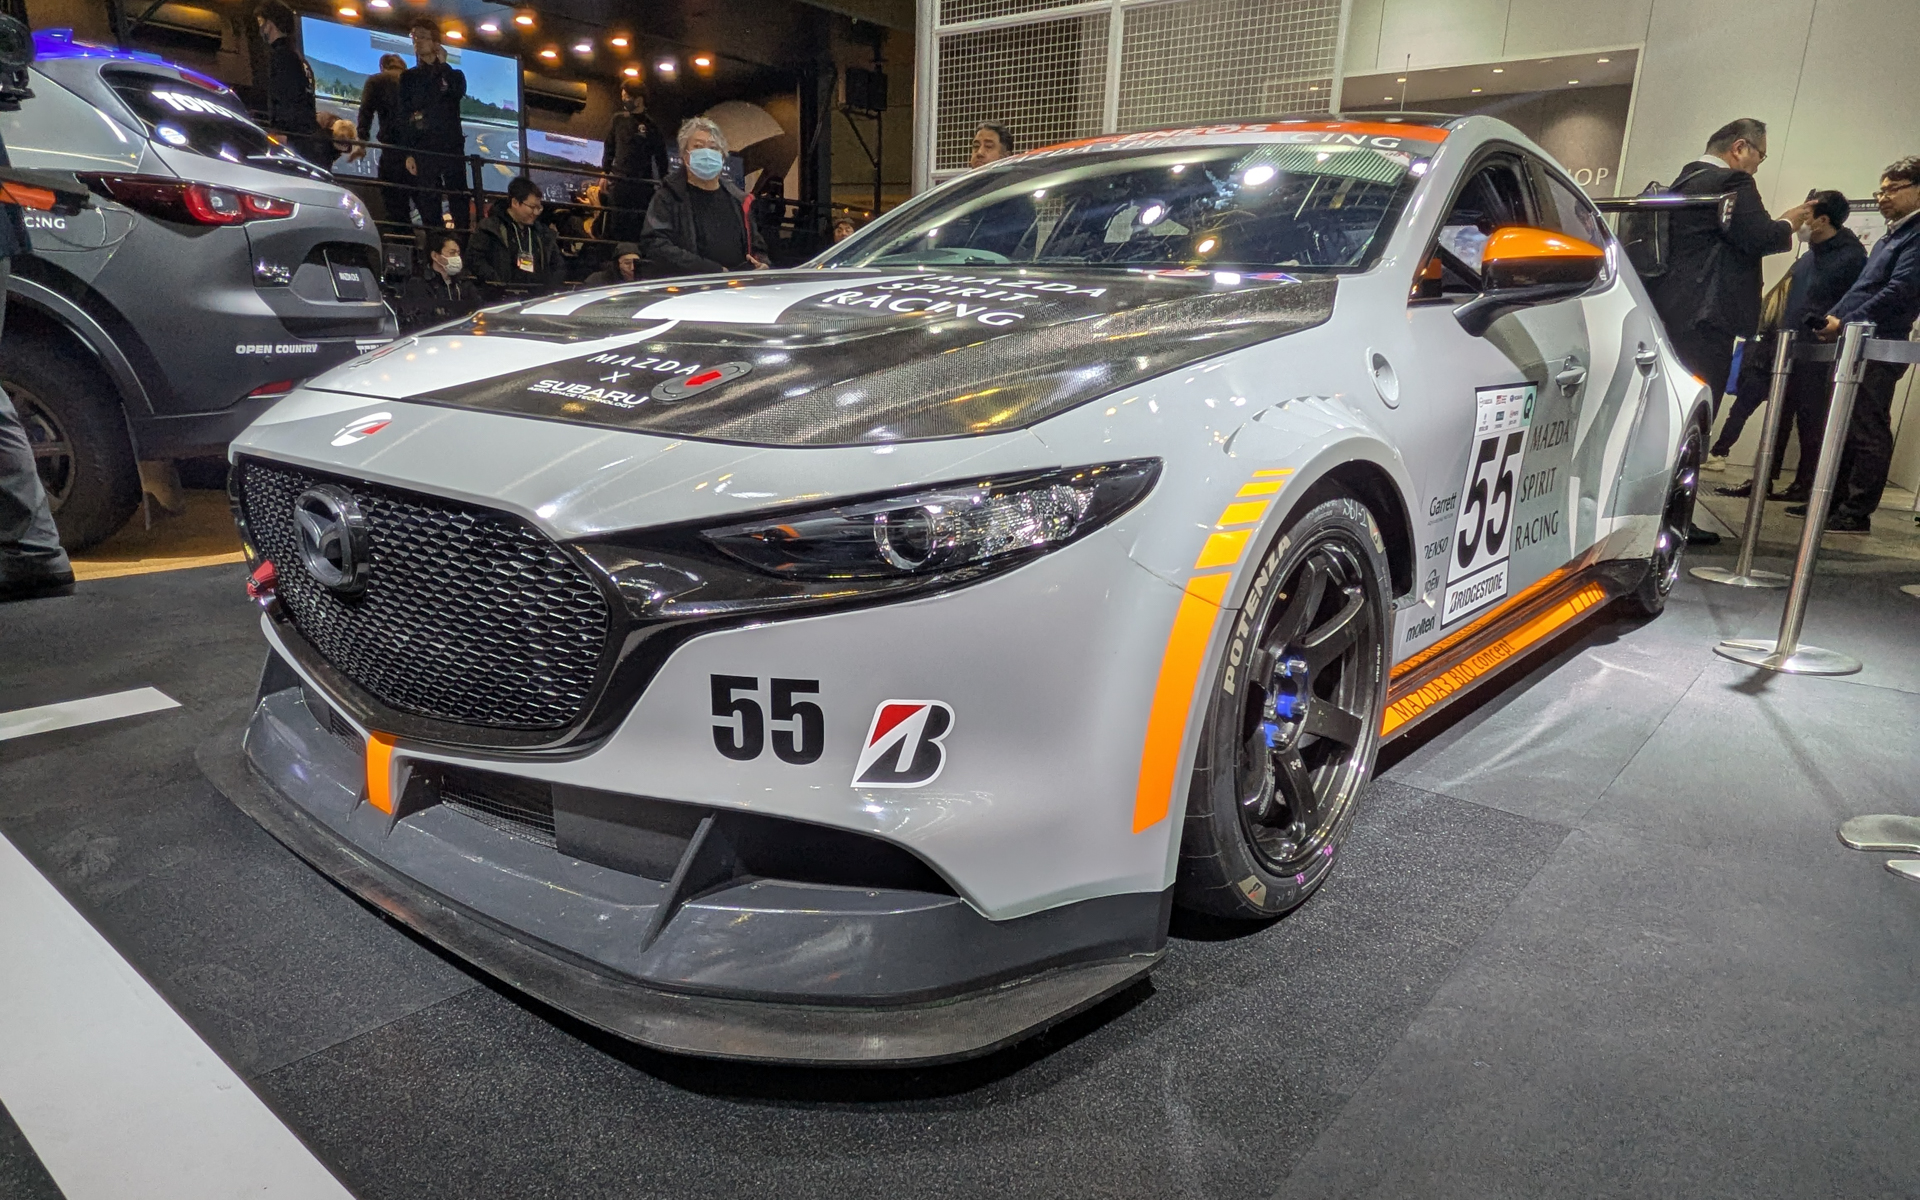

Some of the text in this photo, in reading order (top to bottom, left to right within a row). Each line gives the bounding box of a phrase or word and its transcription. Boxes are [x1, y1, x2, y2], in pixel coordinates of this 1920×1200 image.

[1290, 132, 1402, 149] CING
[1567, 167, 1609, 186] OP
[24, 217, 66, 229] CING
[878, 282, 1039, 302] SPIRIT
[923, 275, 1107, 298] MAZDA
[822, 291, 1025, 327] RACING
[236, 344, 318, 354] OPEN COUNTRY
[587, 353, 701, 376] MAZDA
[533, 379, 649, 405] SUBARU
[549, 390, 578, 398] SPACE
[577, 394, 635, 409] TECHNOLOGY
[1524, 393, 1533, 420] Q
[1530, 420, 1571, 451] MAZDA
[1520, 466, 1557, 503] SPIRIT
[1429, 491, 1457, 517] Garrett
[1457, 430, 1524, 568] 55
[1514, 510, 1560, 552] RACING
[1448, 571, 1503, 615] BRIDGESTONE
[1222, 534, 1292, 696] POTENZA
[1406, 617, 1435, 642] molten
[1393, 677, 1454, 721] MAZDA3
[1451, 663, 1477, 686] BIO
[1471, 639, 1515, 670] concept
[710, 674, 824, 765] 55
